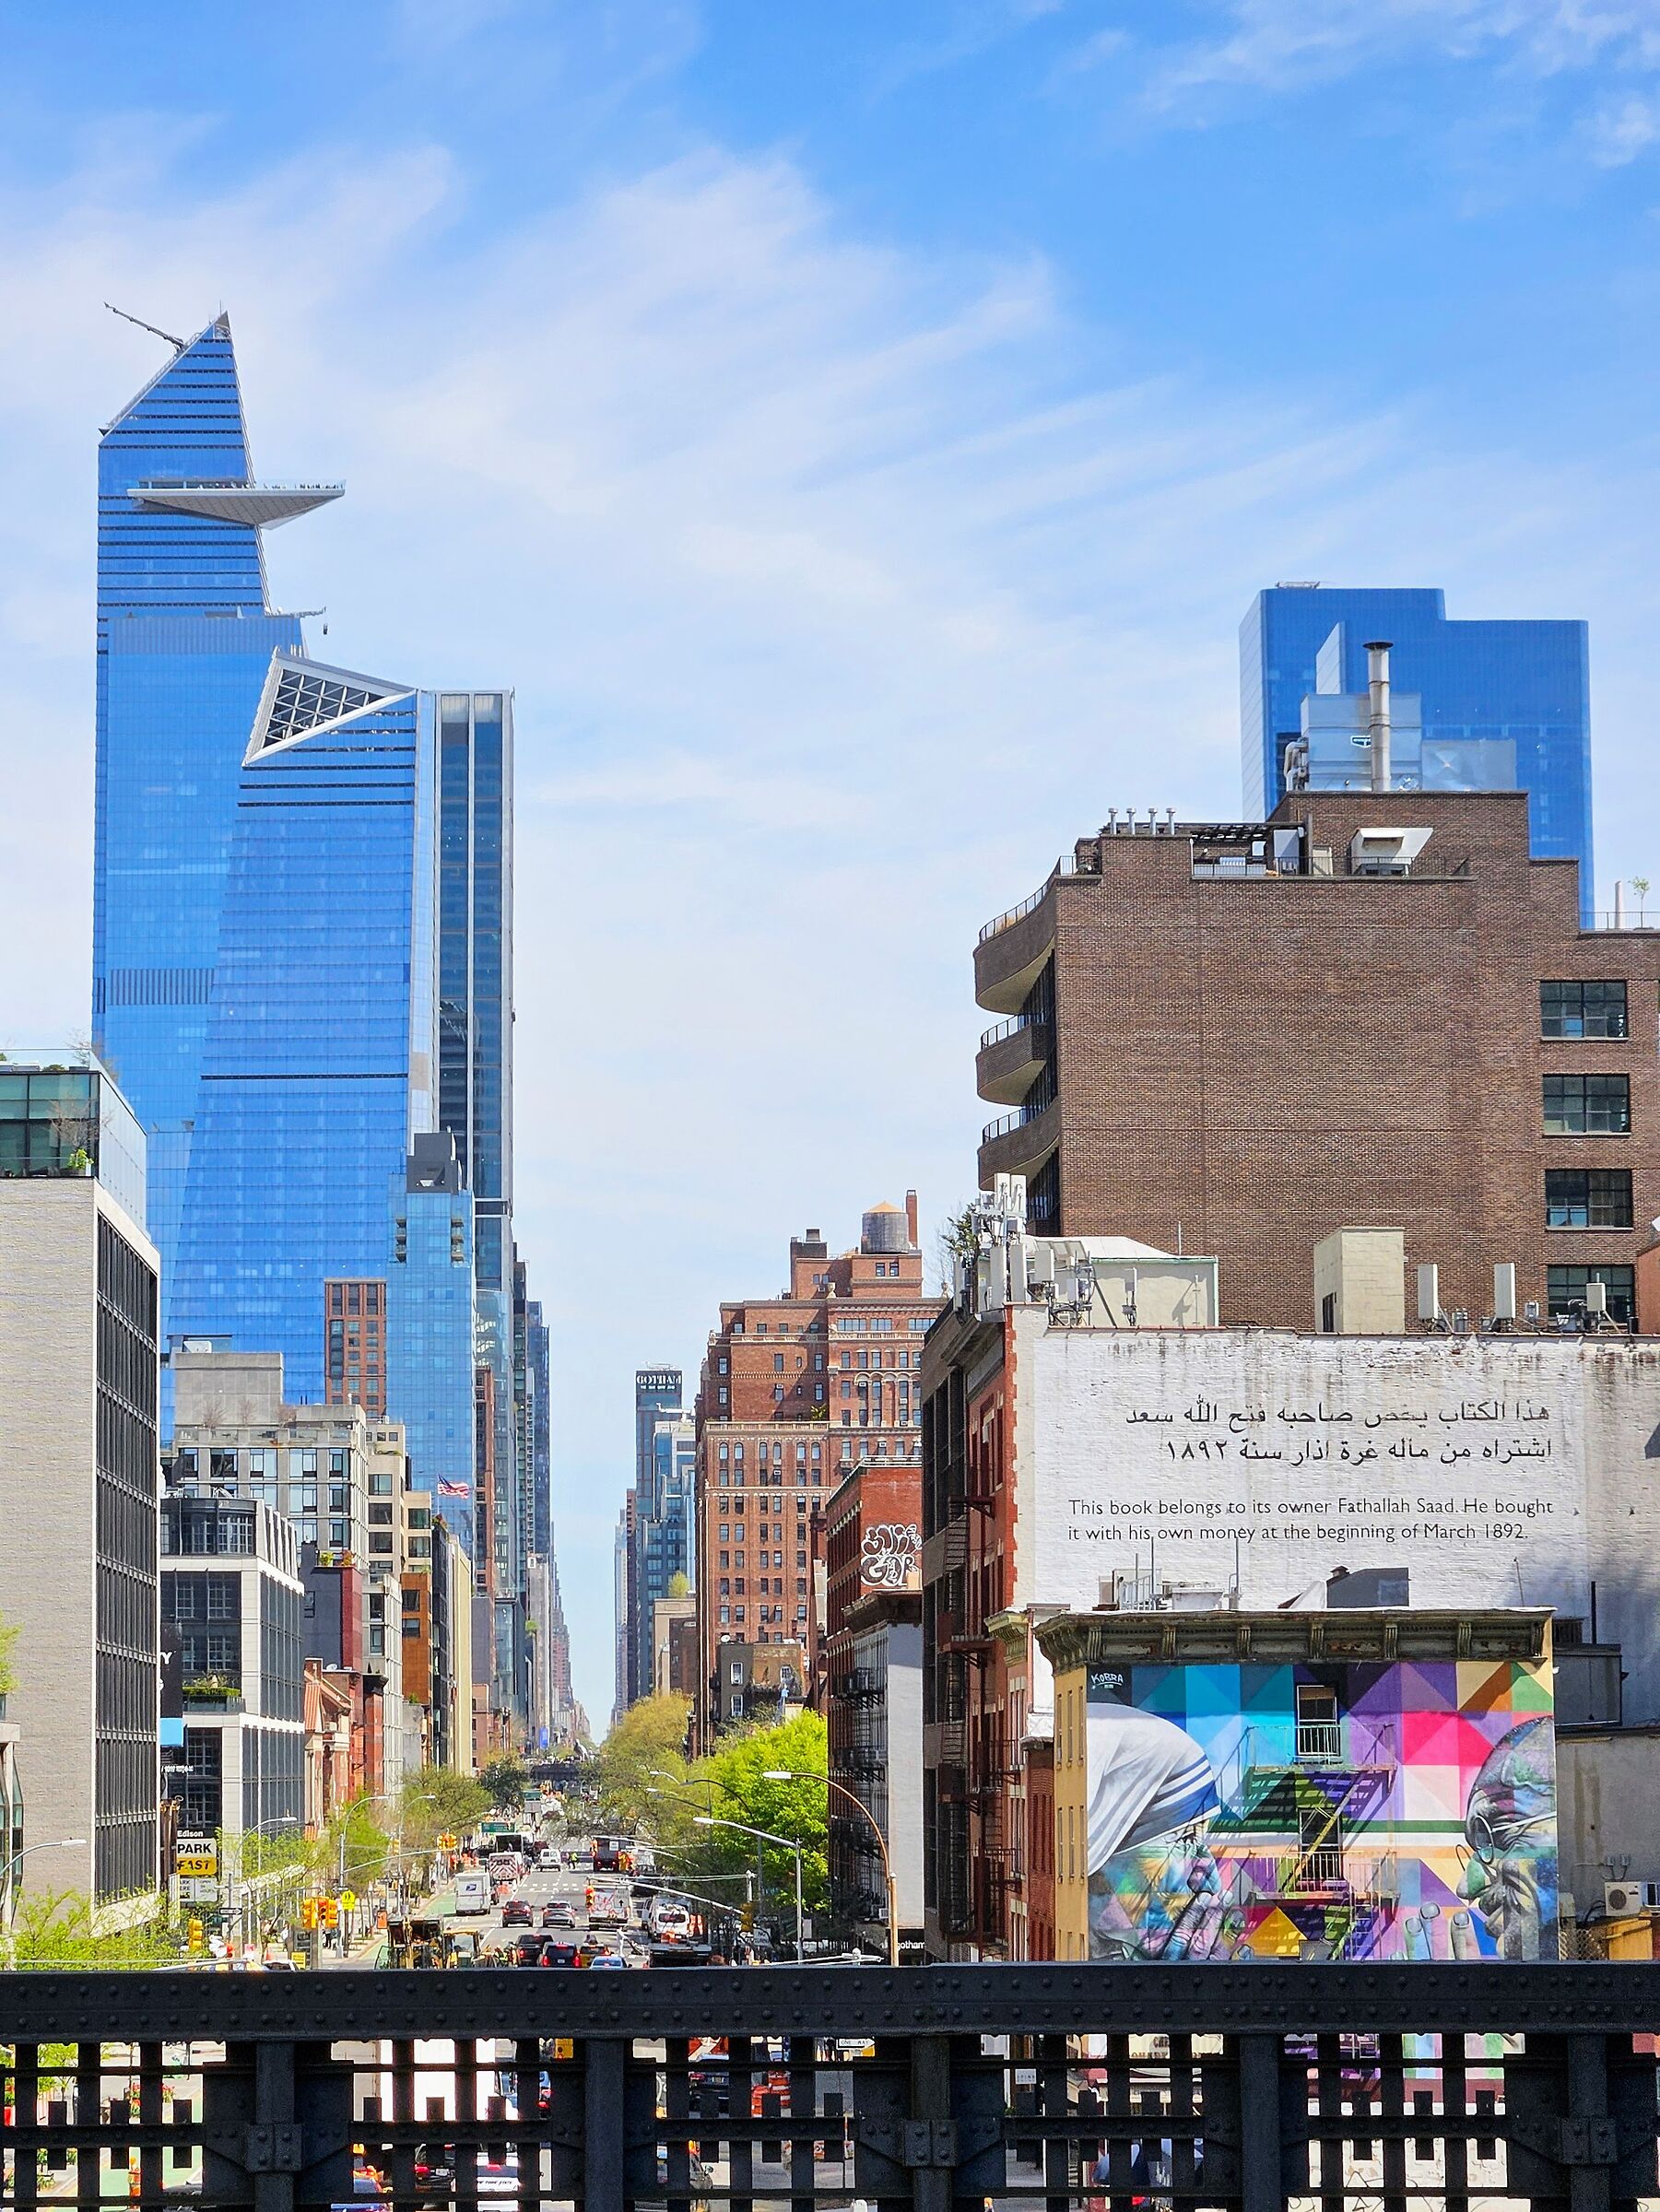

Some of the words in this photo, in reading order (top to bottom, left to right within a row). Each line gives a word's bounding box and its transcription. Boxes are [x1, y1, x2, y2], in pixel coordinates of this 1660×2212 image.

[636, 1374, 682, 1384] GOTHAM
[1124, 1410, 1173, 1424] سعد
[1183, 1394, 1217, 1424] الله
[1229, 1403, 1266, 1433] فتح
[1277, 1402, 1354, 1430] صاحبه
[1364, 1405, 1428, 1428] يخص
[1439, 1399, 1506, 1430] الكتاب
[1514, 1399, 1550, 1423] هذا
[1167, 1439, 1229, 1461] ١٨٩٢
[1240, 1438, 1283, 1460] سنة
[1289, 1440, 1329, 1466] اذار
[1340, 1441, 1380, 1466] غرة
[1388, 1438, 1430, 1459] ماله
[1441, 1443, 1472, 1465] من
[1482, 1438, 1551, 1465] اشتراه
[1068, 1500, 1102, 1514] This
[1111, 1500, 1153, 1514] book
[1158, 1499, 1221, 1518] belongs
[1227, 1502, 1245, 1513] to
[1253, 1500, 1271, 1513] its
[1277, 1501, 1332, 1515] owner
[1339, 1498, 1409, 1512] Fathallah
[1417, 1498, 1458, 1514] Saad.
[1463, 1499, 1488, 1514] He
[1495, 1499, 1554, 1518] bought
[1069, 1526, 1079, 1541] it
[1086, 1524, 1123, 1540] with
[1129, 1524, 1150, 1539] his
[1158, 1529, 1192, 1539] own
[1200, 1526, 1256, 1545] money
[1261, 1527, 1277, 1541] at
[1282, 1524, 1313, 1541] the
[1317, 1524, 1395, 1544] beginning
[1402, 1524, 1420, 1538] of
[1424, 1524, 1477, 1541] March
[1484, 1523, 1529, 1541] 1892.
[1090, 1672, 1124, 1684] KOBRA
[177, 1830, 204, 1838] Edison
[177, 1842, 212, 1854] PARK
